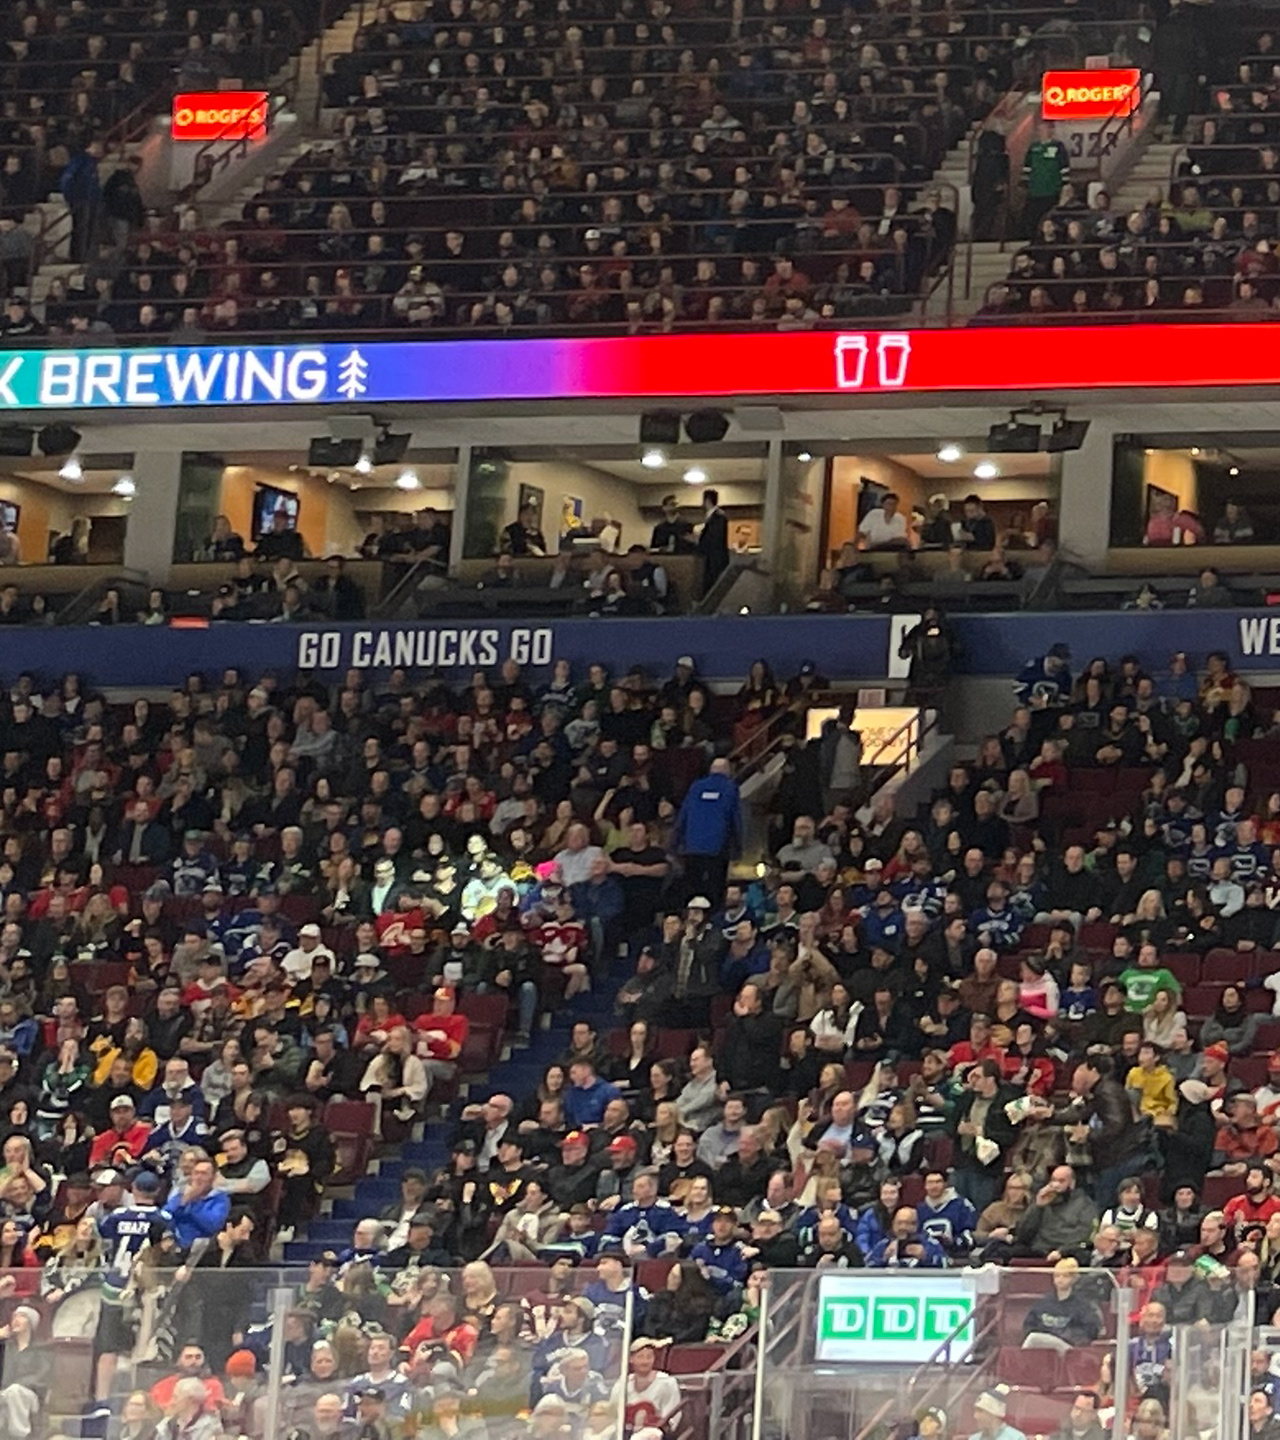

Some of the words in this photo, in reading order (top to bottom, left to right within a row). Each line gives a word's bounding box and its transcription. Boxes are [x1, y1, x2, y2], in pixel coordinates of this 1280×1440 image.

[40, 350, 328, 404] BREWING
[298, 632, 341, 669] GO
[352, 629, 500, 668] CANUCKS
[511, 628, 553, 666] GO
[826, 1302, 865, 1333] TD
[877, 1303, 916, 1334] TD
